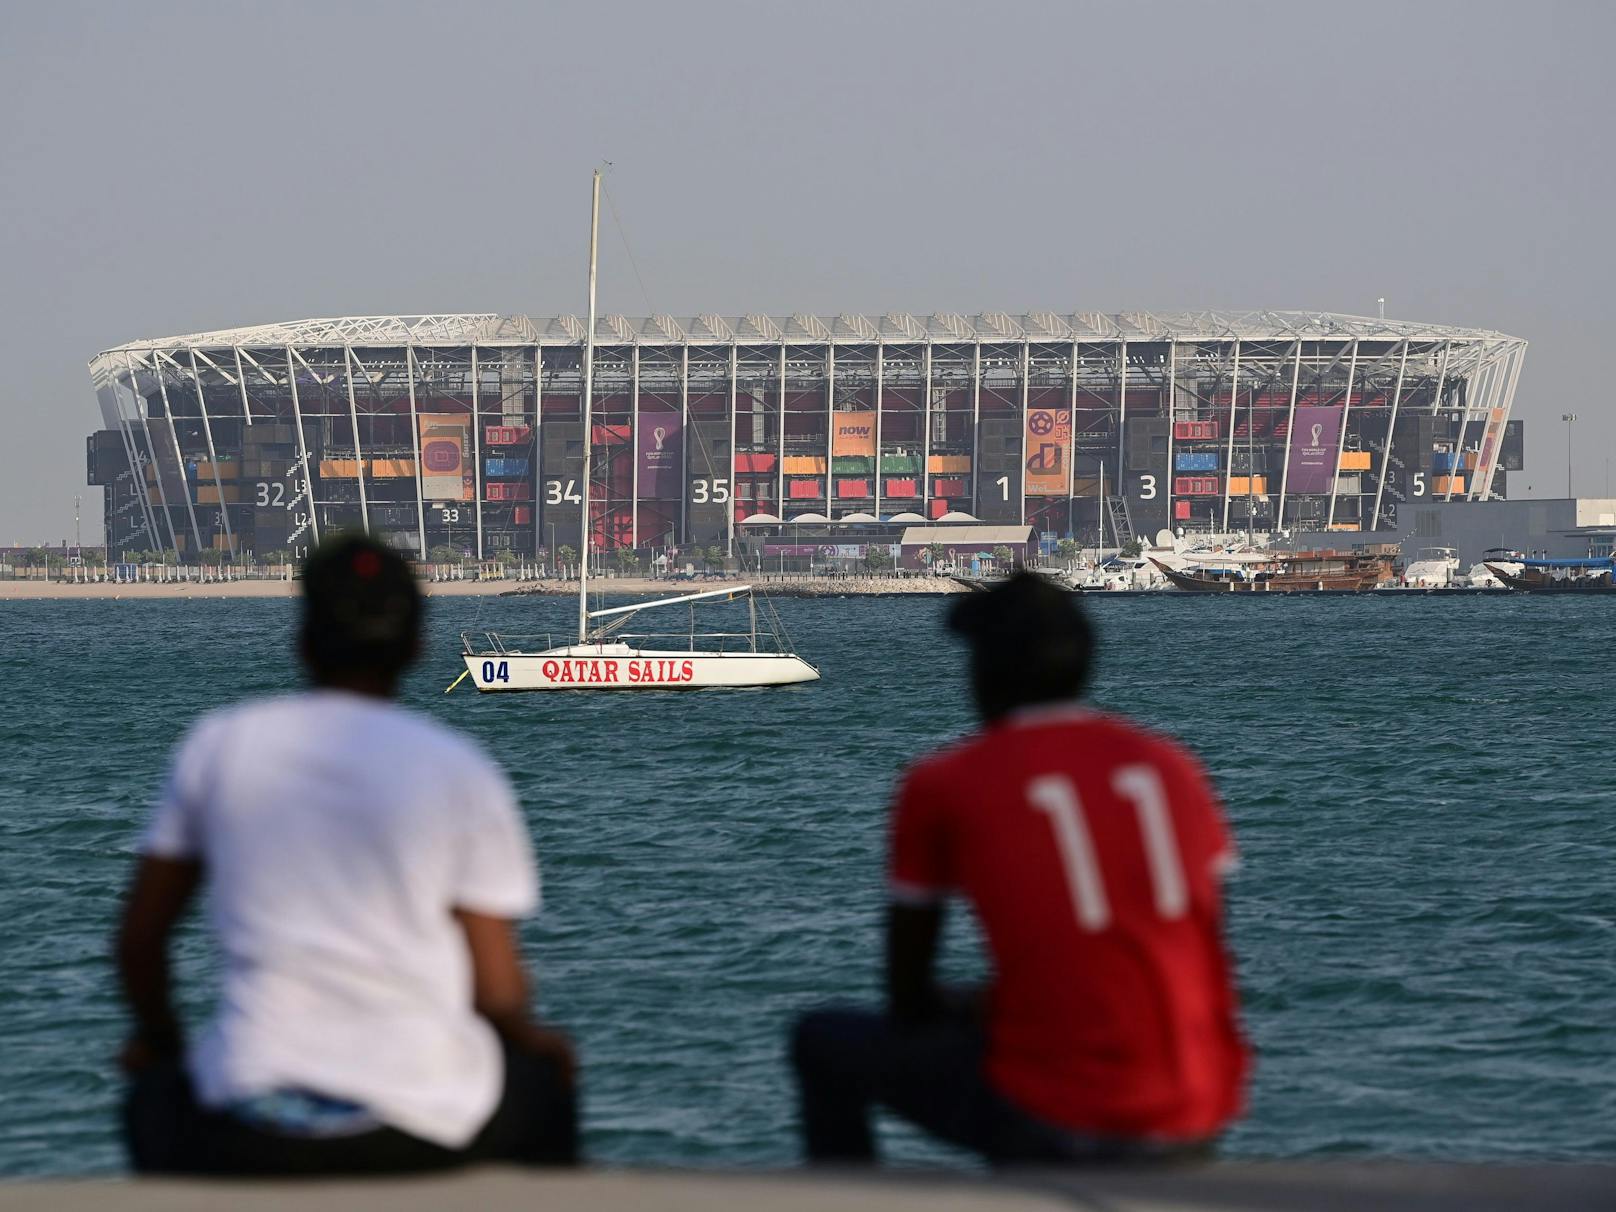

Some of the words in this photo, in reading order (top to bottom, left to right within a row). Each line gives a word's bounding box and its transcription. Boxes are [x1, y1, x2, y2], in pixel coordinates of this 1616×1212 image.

[838, 426, 871, 435] now
[256, 482, 285, 506] 32
[294, 479, 307, 493] L3
[546, 479, 582, 504] 34
[692, 479, 729, 503] 35
[996, 476, 1009, 500] 1
[1140, 475, 1156, 499] 3
[1413, 472, 1425, 496] 5
[295, 513, 307, 526] L2
[442, 509, 459, 522] 33
[295, 545, 308, 559] L1
[481, 660, 510, 683] 04
[542, 660, 620, 683] QATAR
[627, 660, 694, 683] SAILS
[1026, 765, 1188, 930] 11
